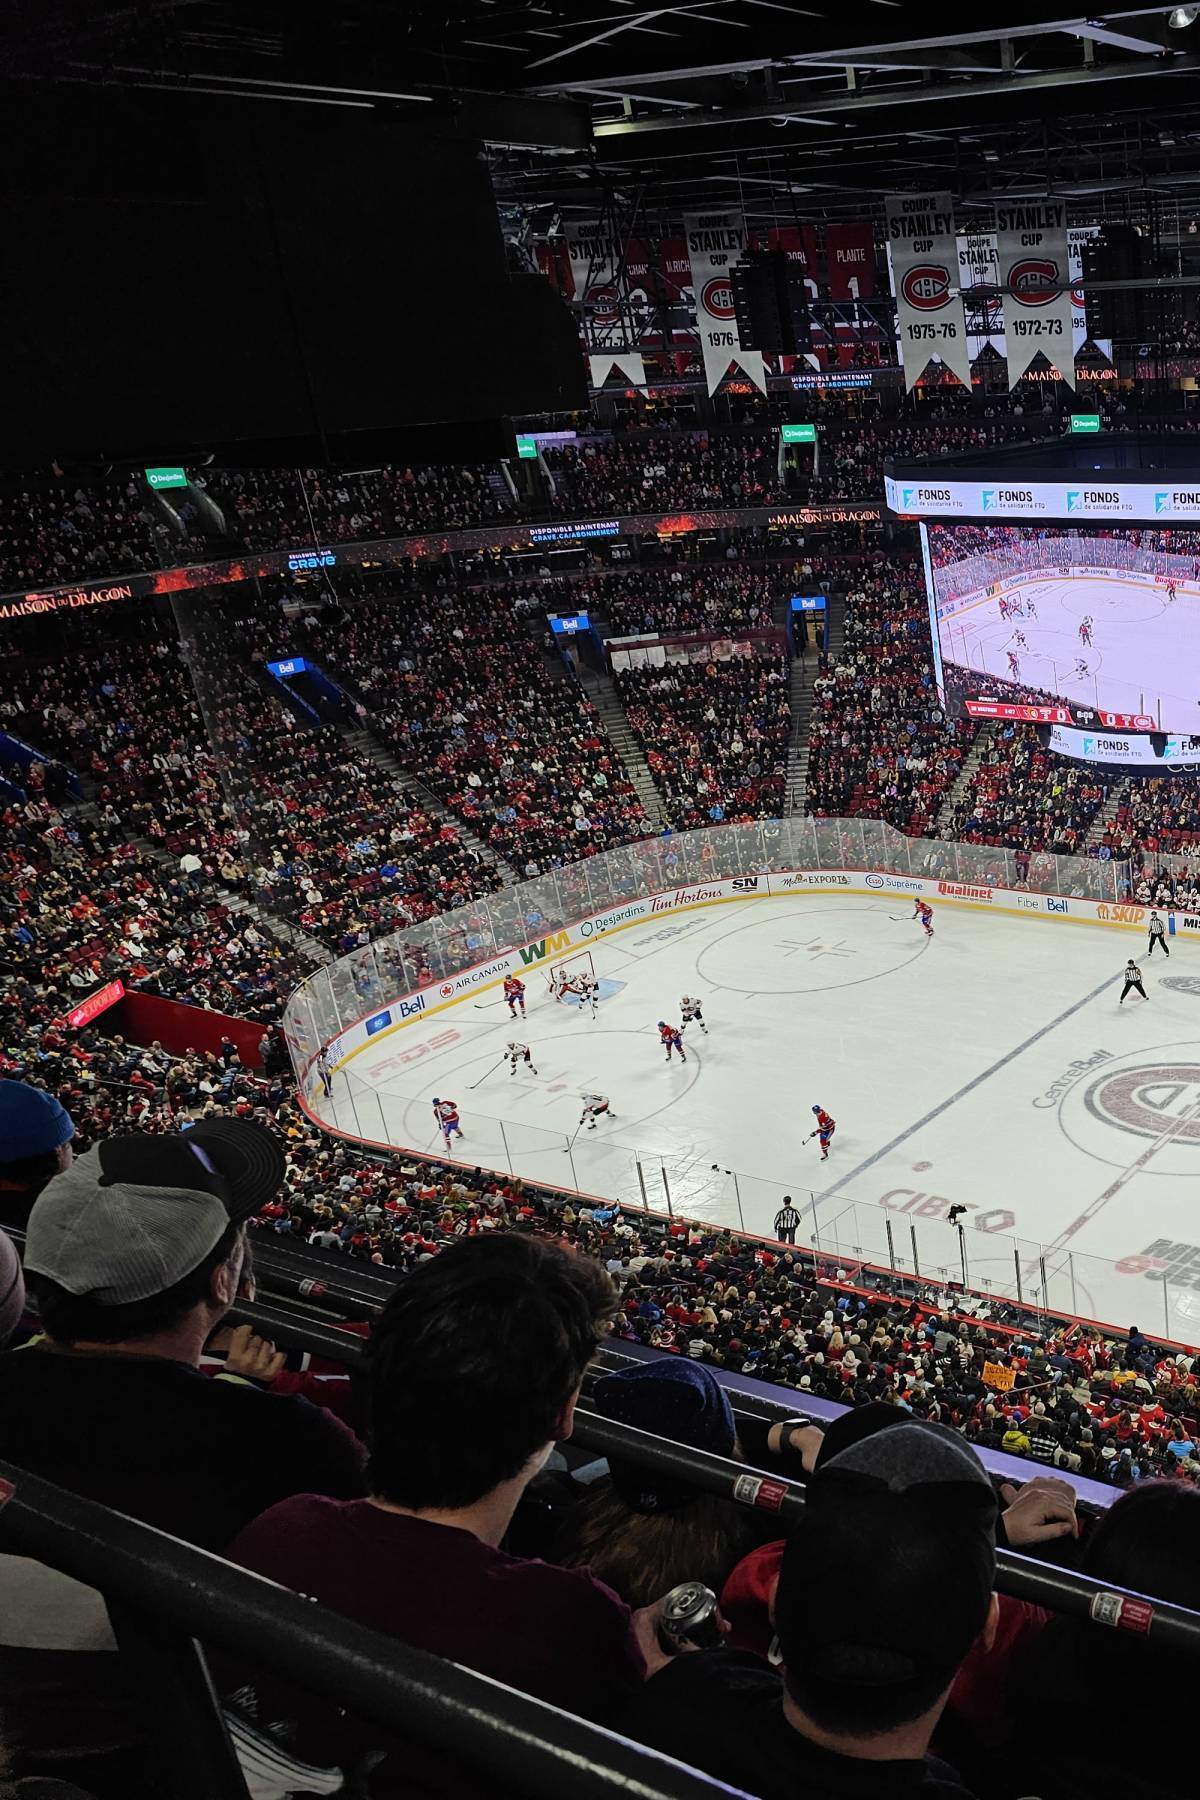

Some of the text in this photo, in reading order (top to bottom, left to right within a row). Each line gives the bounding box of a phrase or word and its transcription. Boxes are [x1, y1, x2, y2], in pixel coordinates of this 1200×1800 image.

[902, 198, 937, 213] COUPE
[890, 213, 952, 240] STANLEY
[998, 206, 1063, 232] STANLEY
[689, 231, 744, 252] STANLEY
[913, 240, 934, 253] CUP
[1022, 235, 1043, 247] CUP
[709, 255, 728, 270] CUP
[836, 248, 866, 263] PLANTE
[907, 323, 957, 340] 1975-76
[1013, 319, 1063, 338] 1972-73
[918, 489, 950, 501] FONDS
[998, 490, 1033, 502] FONDS
[1084, 491, 1120, 504] FONDS
[777, 512, 822, 525] MAISON
[832, 509, 881, 522] DRAGON
[530, 521, 620, 536] DISPONIBLE MAINTENANT
[70, 586, 133, 608] DRAGON
[802, 599, 816, 609] Bell
[562, 619, 578, 630] Bell
[279, 663, 294, 674] Bell
[1097, 740, 1130, 752] FONDS
[731, 876, 758, 890] SN
[886, 877, 924, 891] Suprême
[937, 881, 993, 900] Qualinet
[649, 888, 722, 913] Tim Hortons
[1017, 895, 1069, 914] Fibe Bell
[595, 906, 646, 930] Desjardins
[1110, 904, 1146, 924] SKIP
[518, 929, 572, 966] WM
[455, 960, 511, 991] AIR CANADA
[399, 995, 425, 1018] Bell
